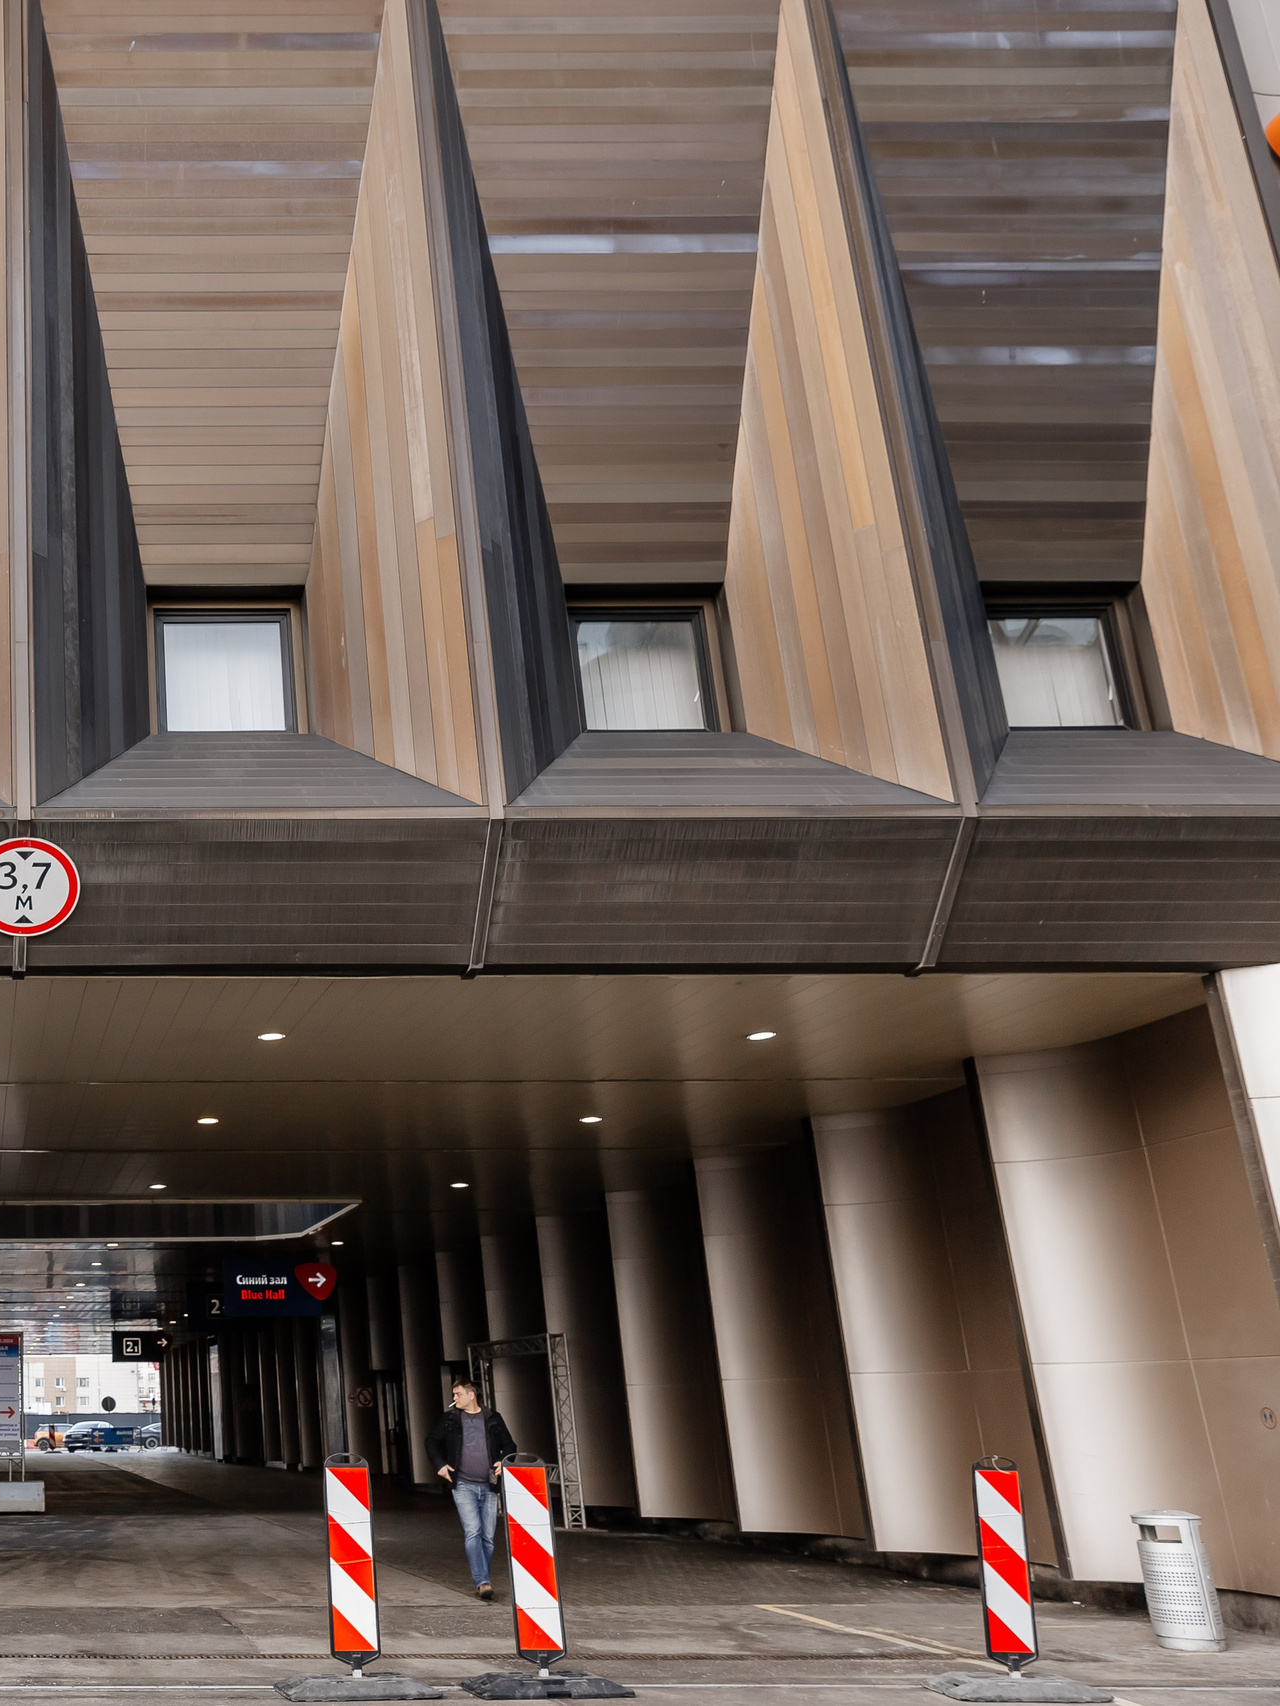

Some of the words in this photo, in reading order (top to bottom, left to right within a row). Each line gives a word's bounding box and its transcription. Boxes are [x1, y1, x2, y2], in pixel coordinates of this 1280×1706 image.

[236, 1274, 268, 1285] Синий
[269, 1276, 287, 1285] зал
[241, 1289, 263, 1300] Blue
[265, 1289, 285, 1300] Hall
